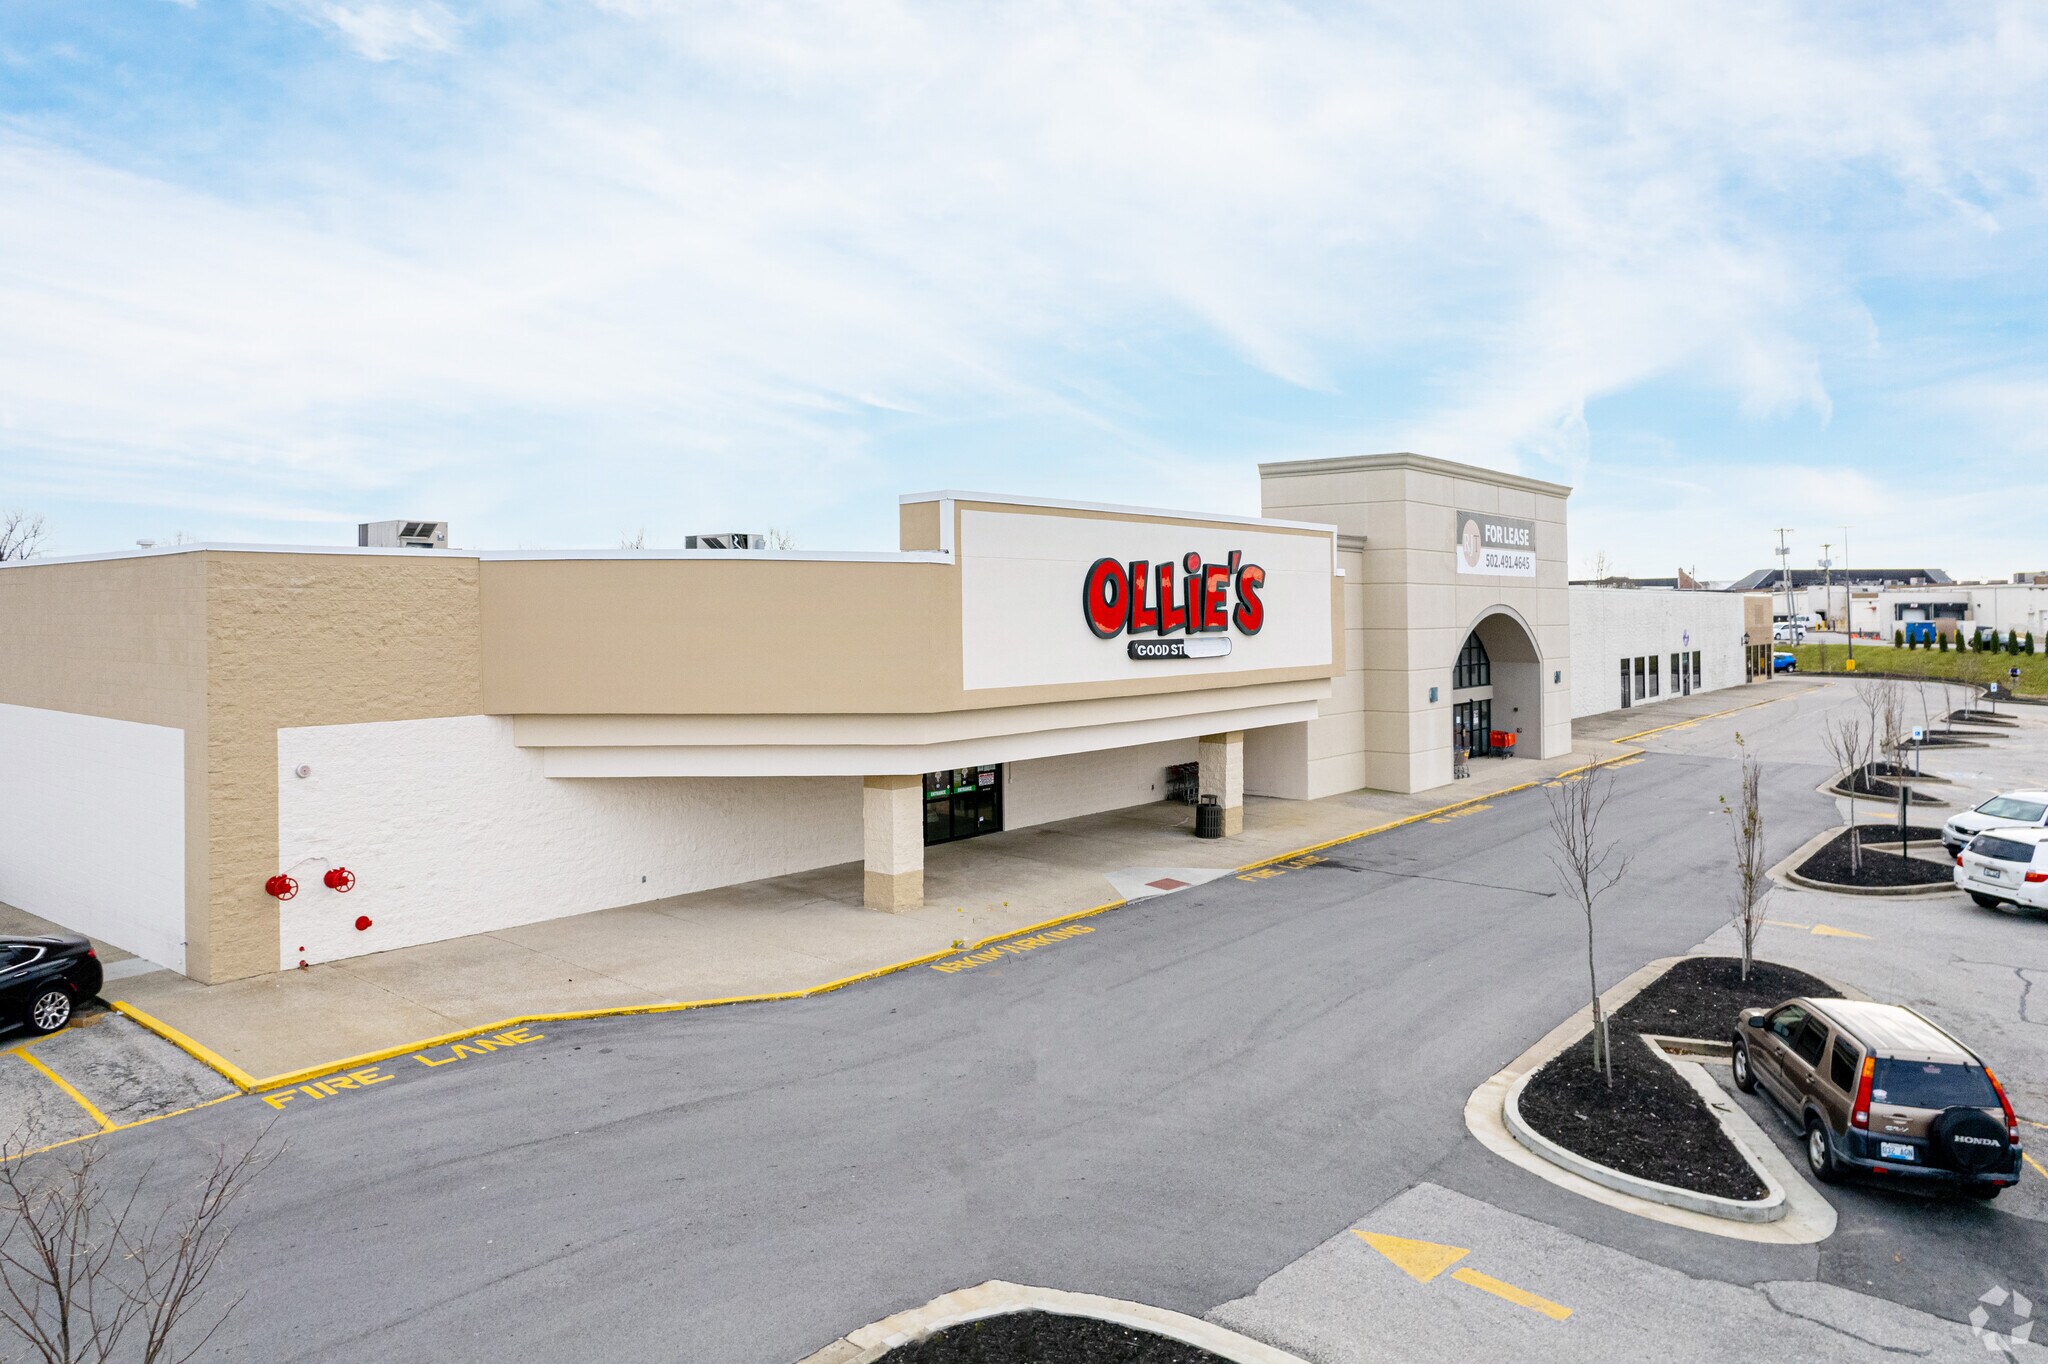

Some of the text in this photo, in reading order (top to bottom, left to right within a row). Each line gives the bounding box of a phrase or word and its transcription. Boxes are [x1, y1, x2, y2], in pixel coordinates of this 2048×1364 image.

[1485, 524, 1530, 546] FOR LEASE
[1485, 553, 1530, 570] 502.491.4645
[261, 1027, 545, 1111] FIRE LANE
[1954, 1135, 2001, 1147] HONDA
